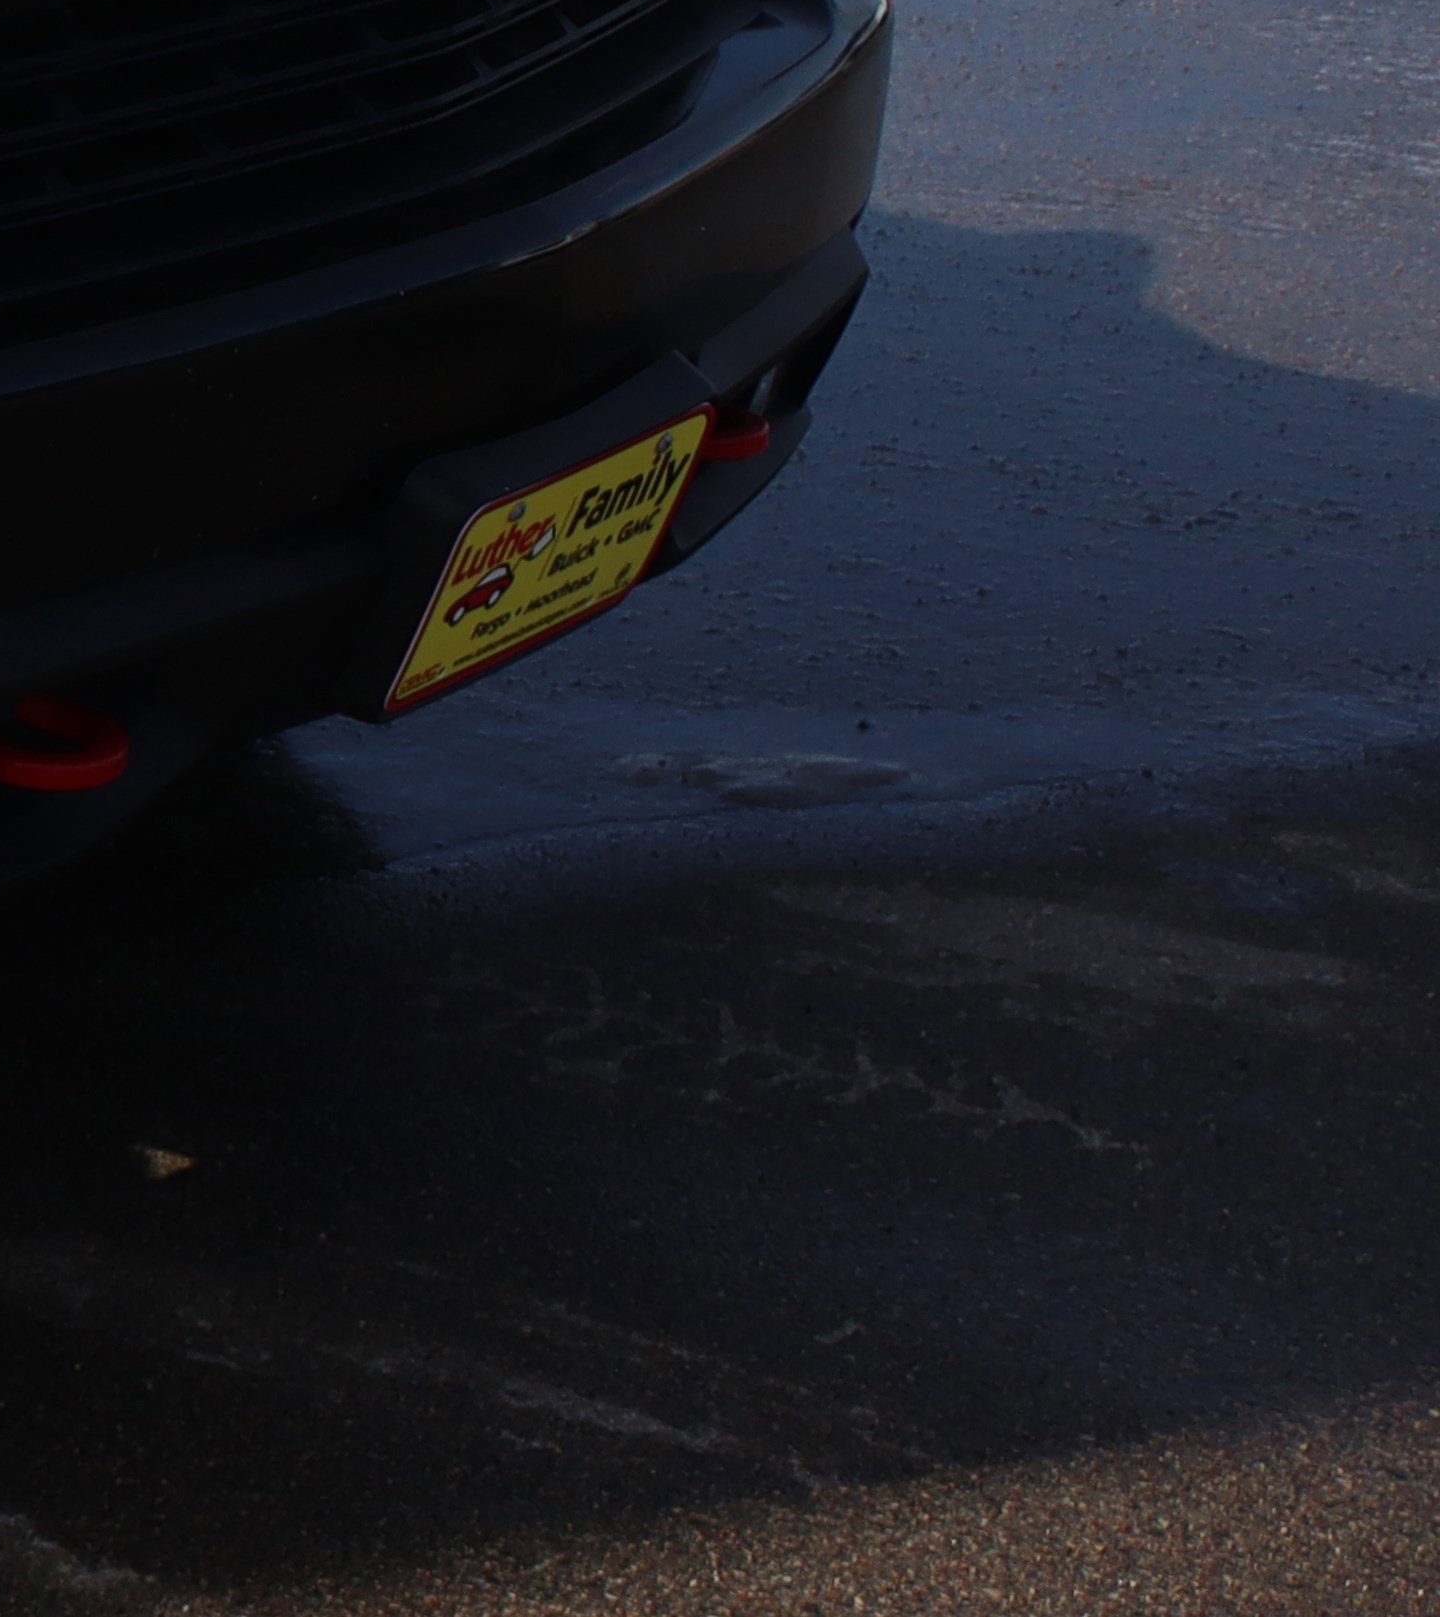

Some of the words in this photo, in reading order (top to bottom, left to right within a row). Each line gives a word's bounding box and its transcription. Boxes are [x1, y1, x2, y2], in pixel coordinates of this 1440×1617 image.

[566, 449, 692, 538] Family
[449, 514, 556, 586] Luther
[547, 537, 601, 577] Buick
